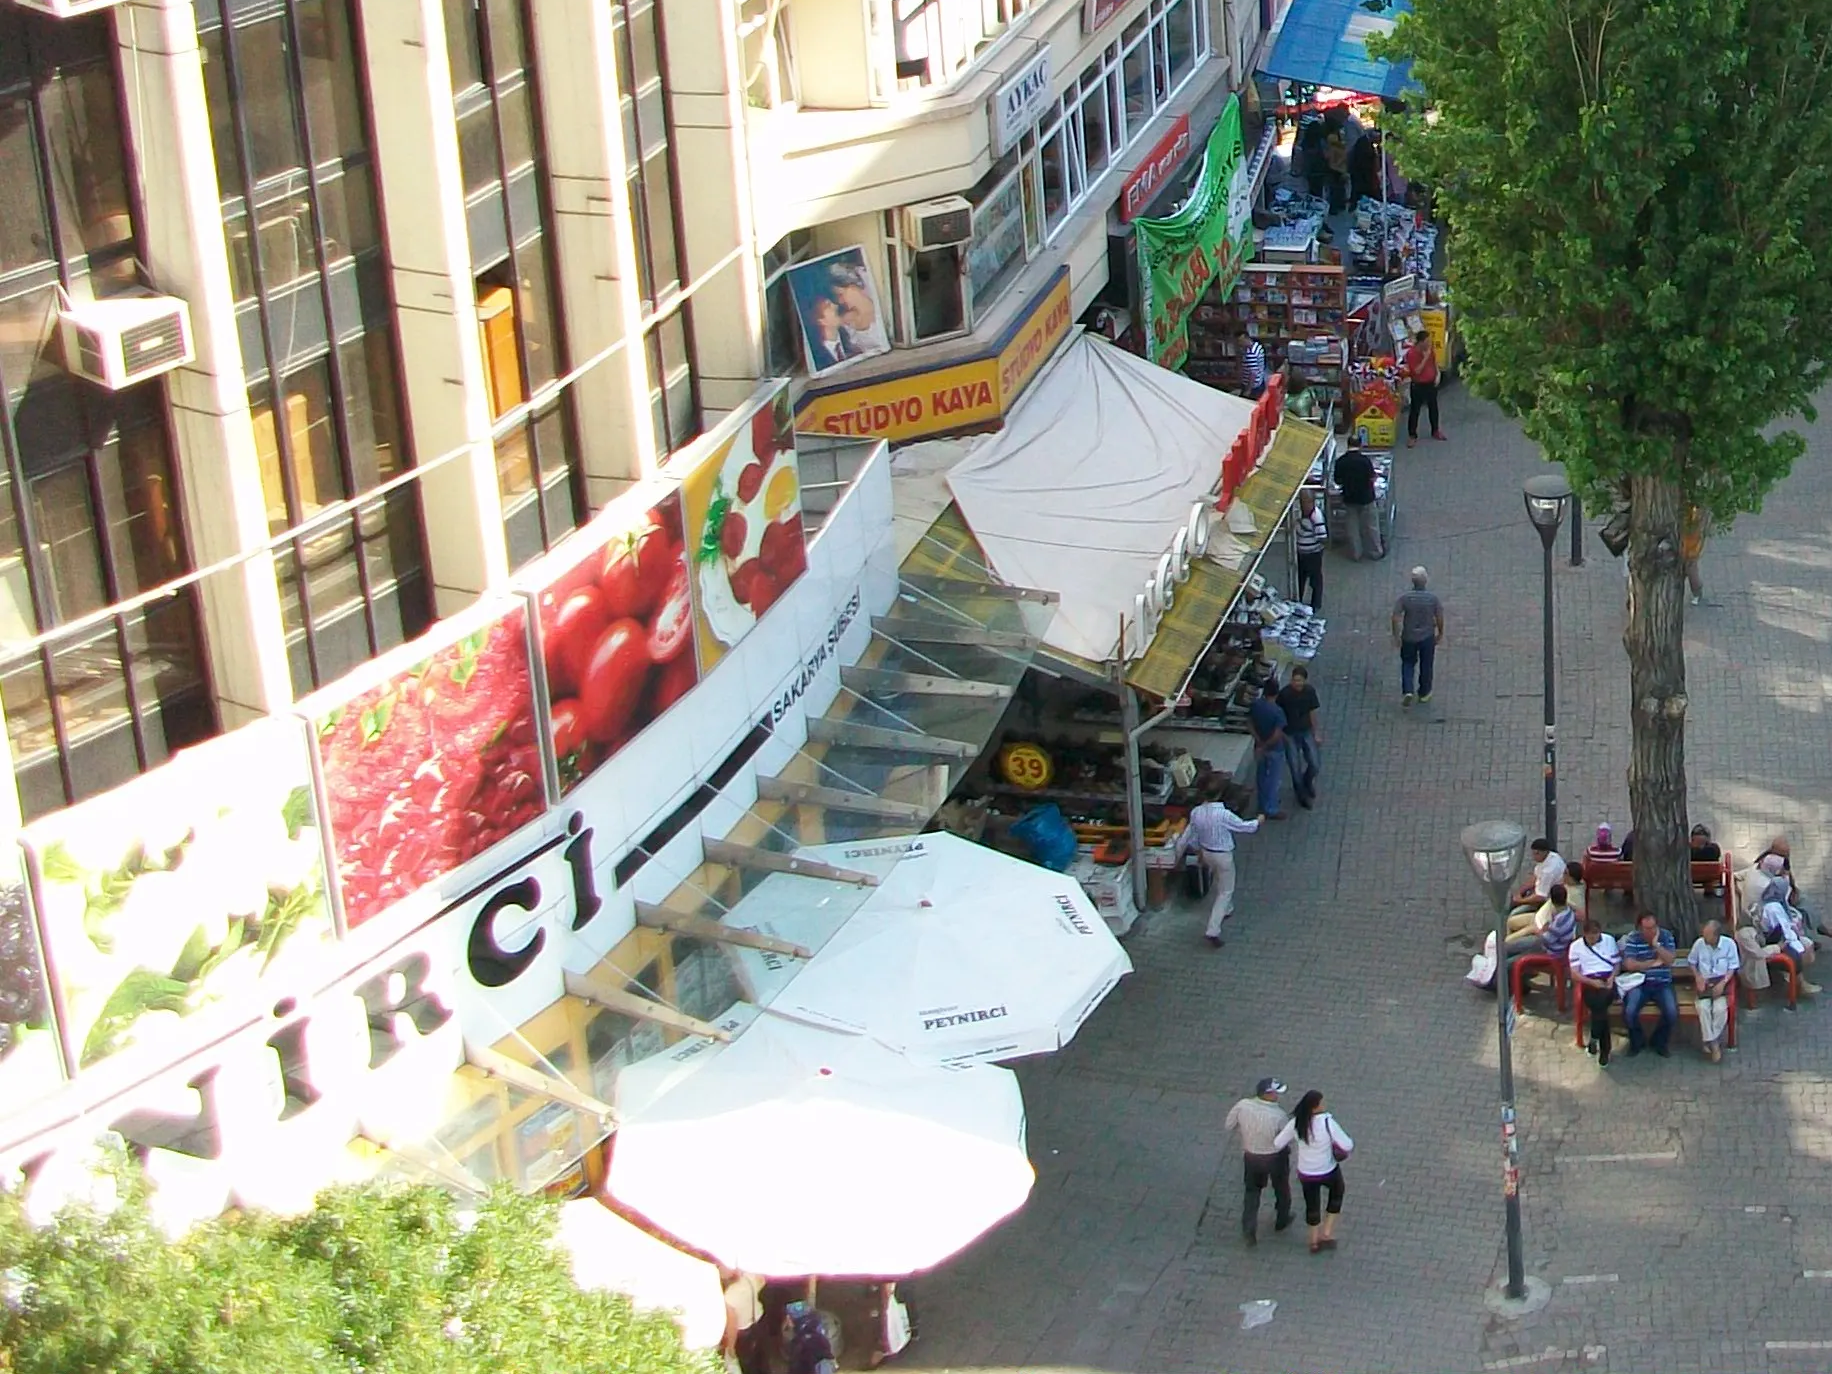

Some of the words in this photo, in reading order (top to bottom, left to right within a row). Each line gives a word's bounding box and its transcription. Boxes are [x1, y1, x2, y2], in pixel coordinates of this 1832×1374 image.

[1001, 327, 1043, 395] STÜDYO
[1045, 294, 1070, 337] KAYA
[823, 395, 923, 435] STÜDYO
[932, 380, 993, 417] KAYA
[774, 642, 827, 724] SAKARYA
[1012, 756, 1043, 779] 39
